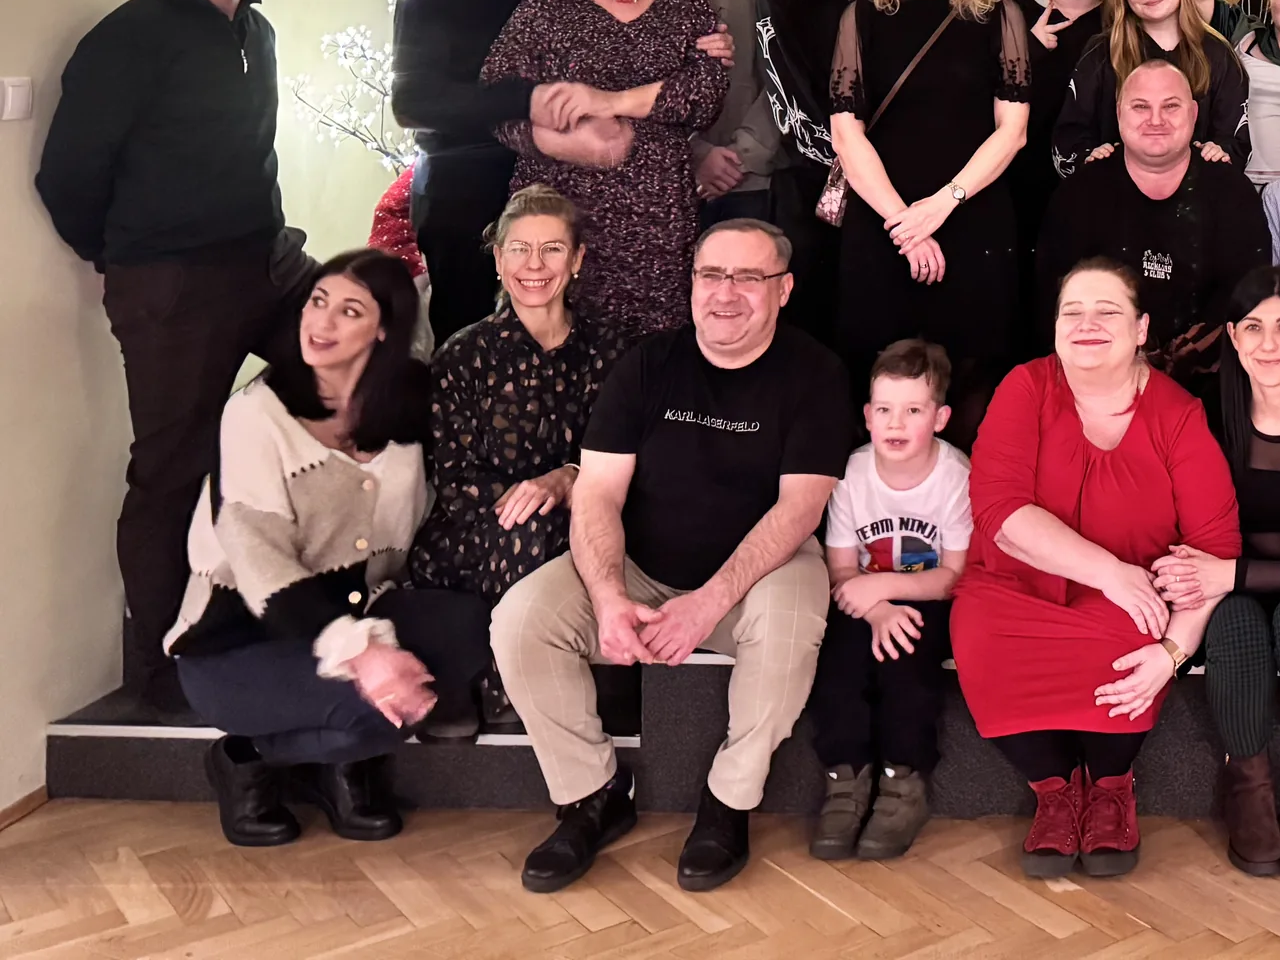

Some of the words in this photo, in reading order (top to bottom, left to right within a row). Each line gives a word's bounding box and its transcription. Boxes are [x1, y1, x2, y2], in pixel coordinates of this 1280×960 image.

[1149, 270, 1165, 279] CLUB
[664, 409, 696, 422] KARL
[697, 413, 760, 432] LAGERFELD
[855, 518, 894, 542] TEAM
